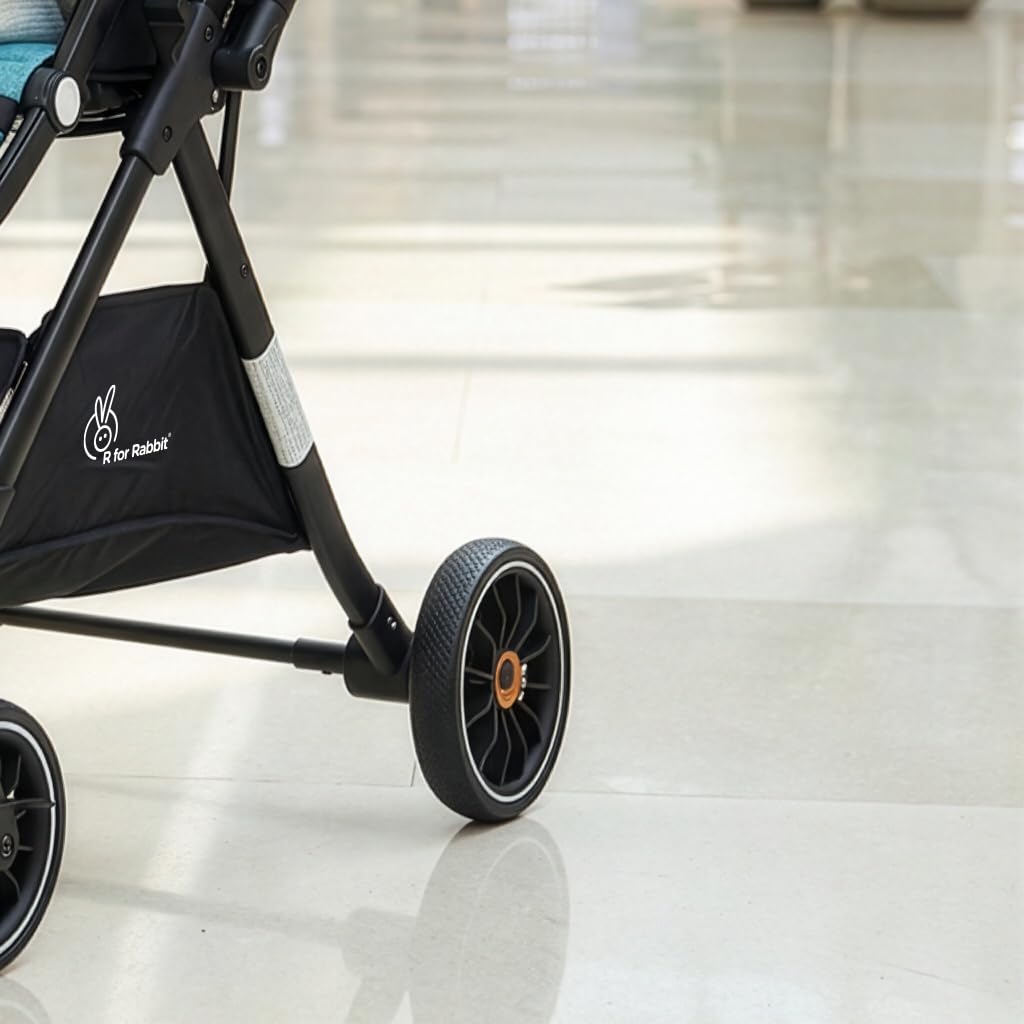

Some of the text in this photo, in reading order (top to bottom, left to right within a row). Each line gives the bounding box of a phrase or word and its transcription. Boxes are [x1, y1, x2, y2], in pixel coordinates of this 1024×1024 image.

[102, 436, 169, 465] R for Rabbit
